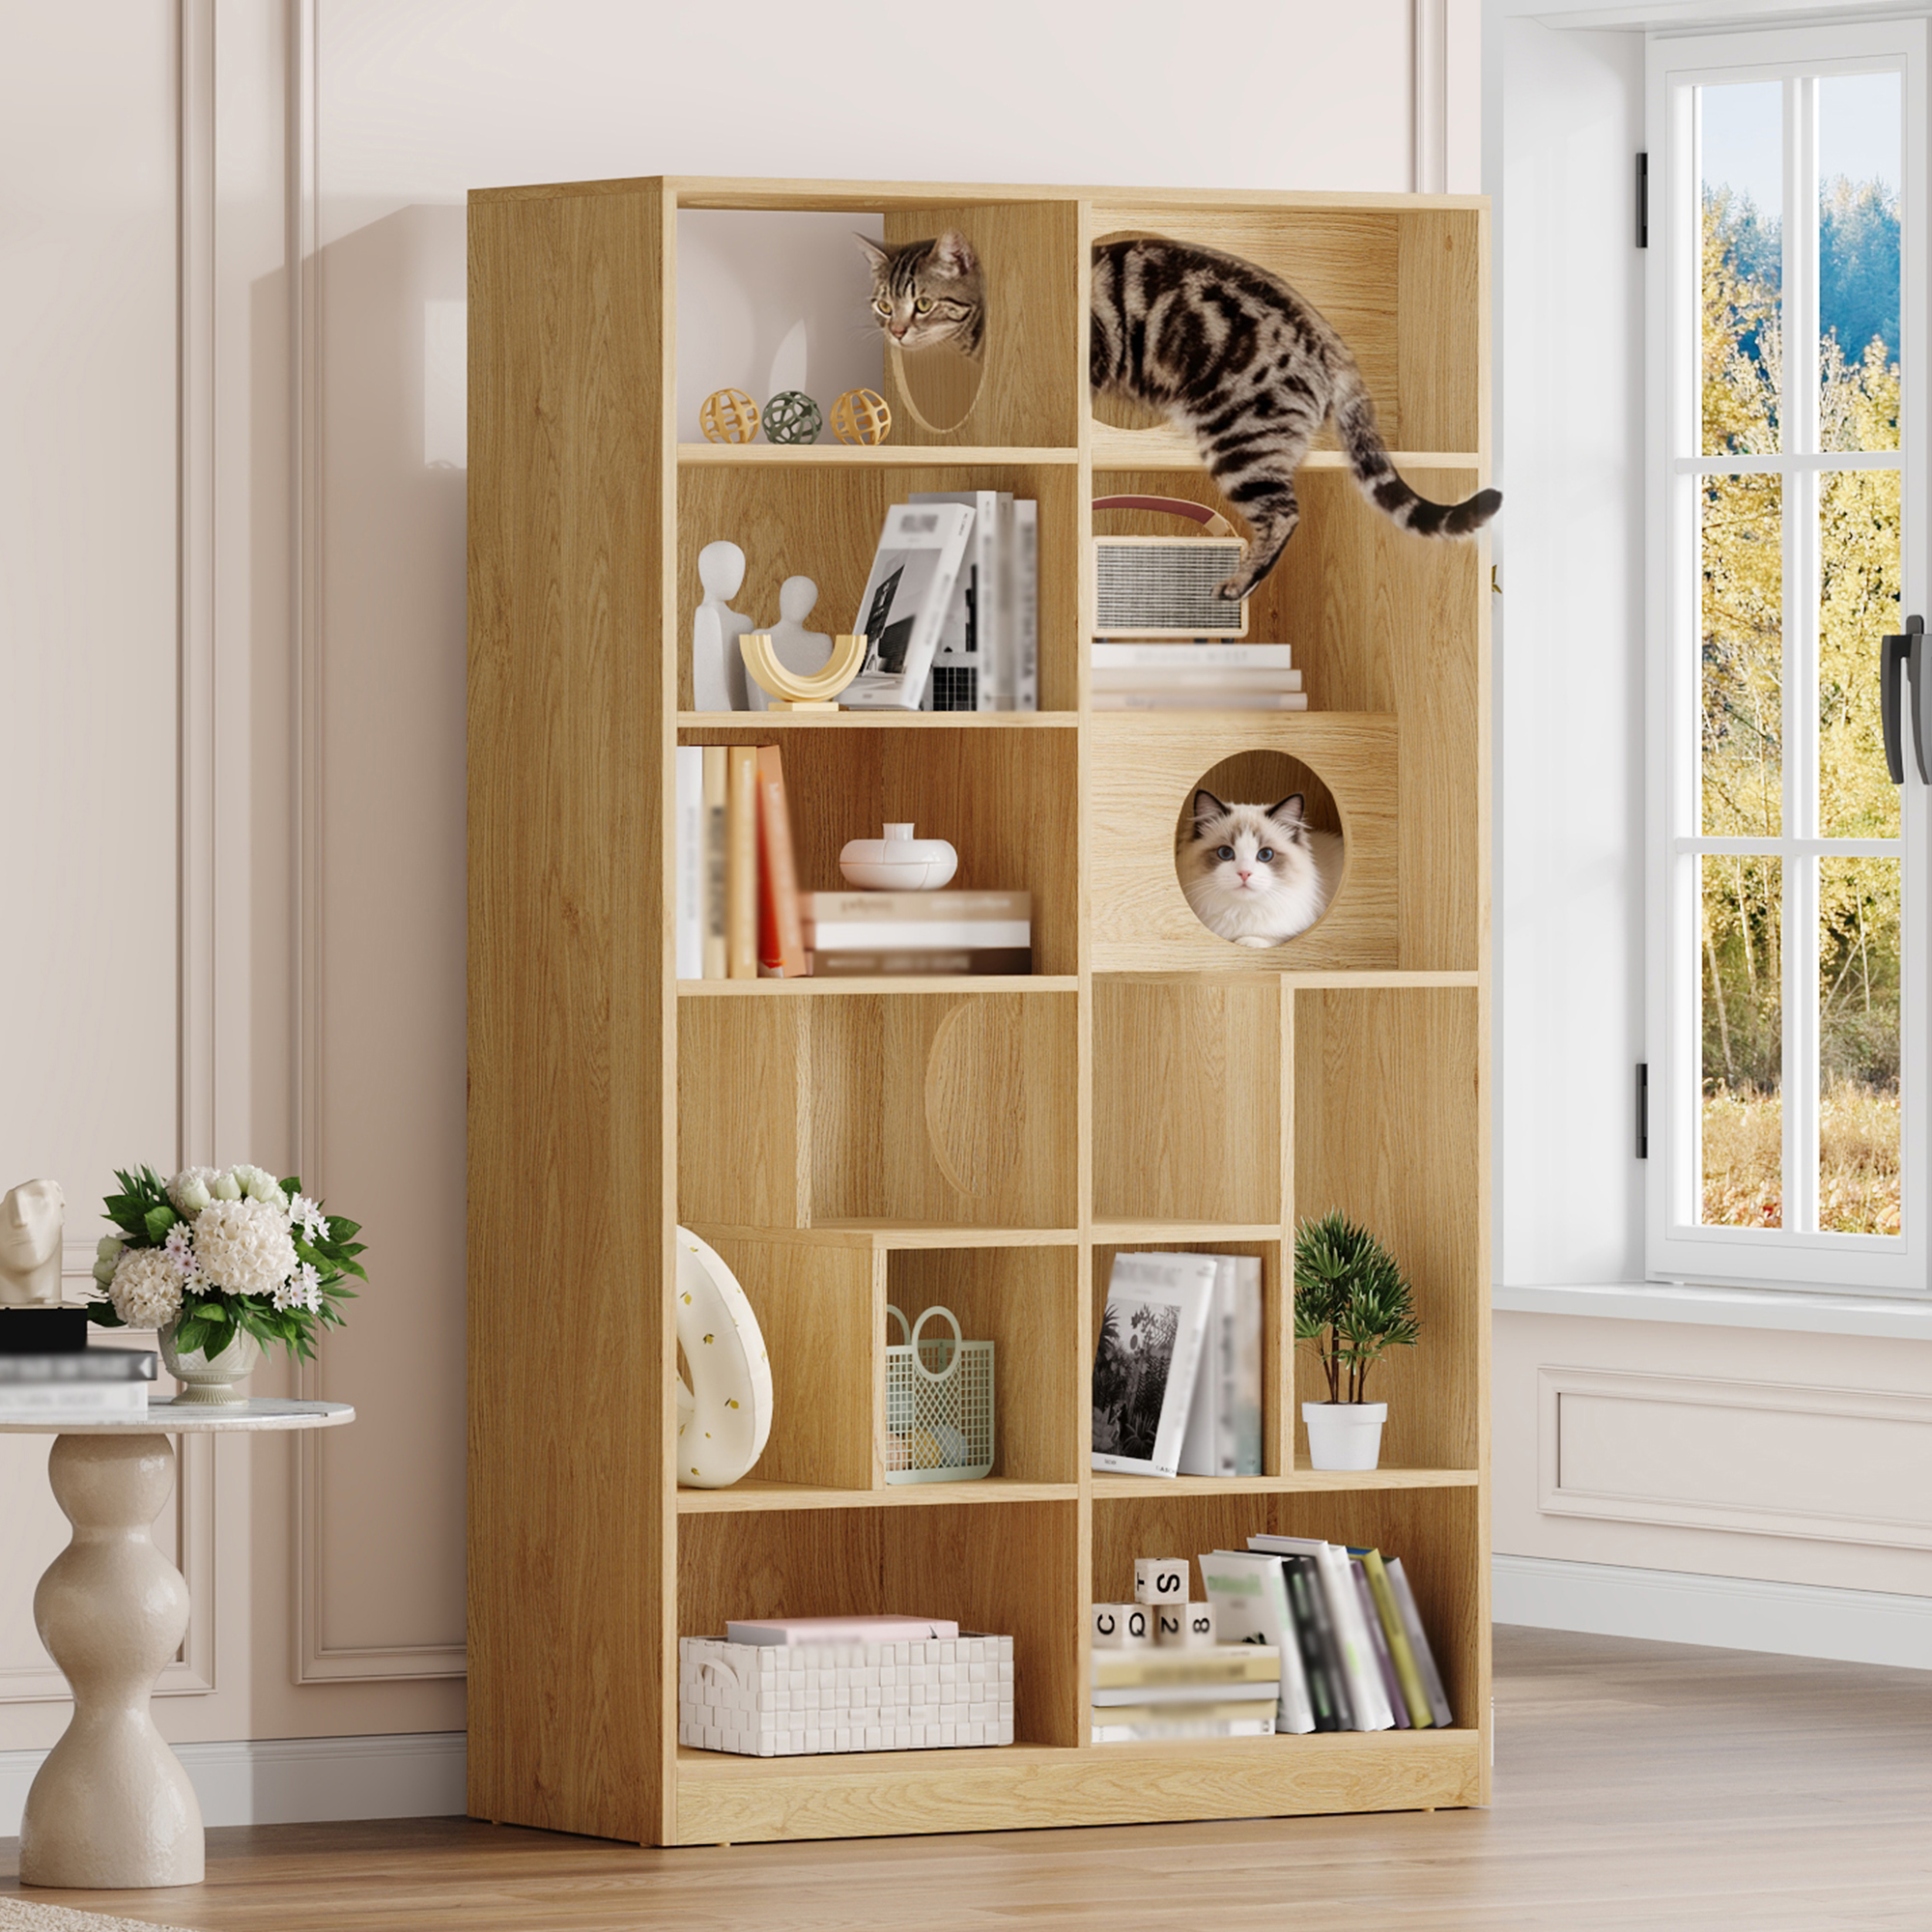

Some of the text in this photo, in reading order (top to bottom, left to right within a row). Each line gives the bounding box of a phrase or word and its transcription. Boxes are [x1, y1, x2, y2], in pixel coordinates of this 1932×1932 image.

[1156, 1573, 1180, 1593] S
[1129, 1611, 1146, 1637] Q
[1160, 1616, 1179, 1634] 2
[1193, 1617, 1209, 1634] 8
